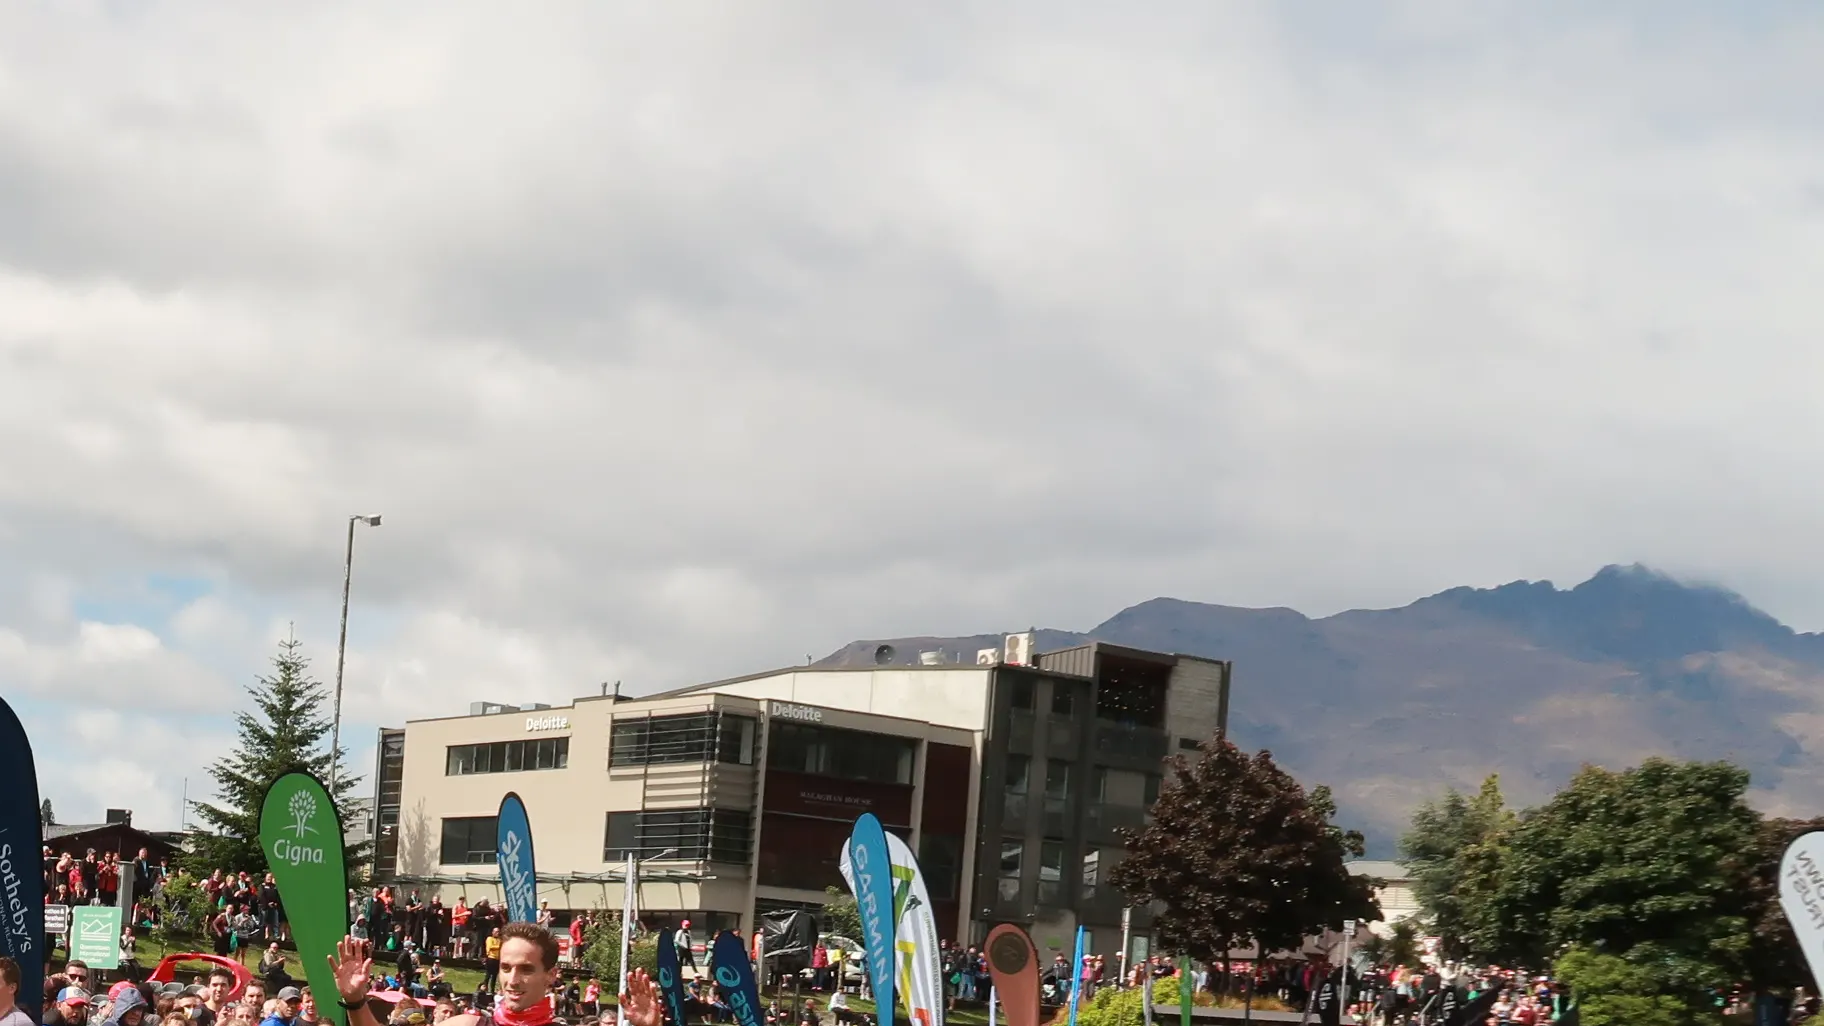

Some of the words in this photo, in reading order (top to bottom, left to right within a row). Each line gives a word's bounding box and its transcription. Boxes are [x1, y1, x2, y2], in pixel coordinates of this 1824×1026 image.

[772, 702, 822, 722] Deloitte
[273, 839, 324, 866] Cigna
[856, 843, 889, 985] GARMIN
